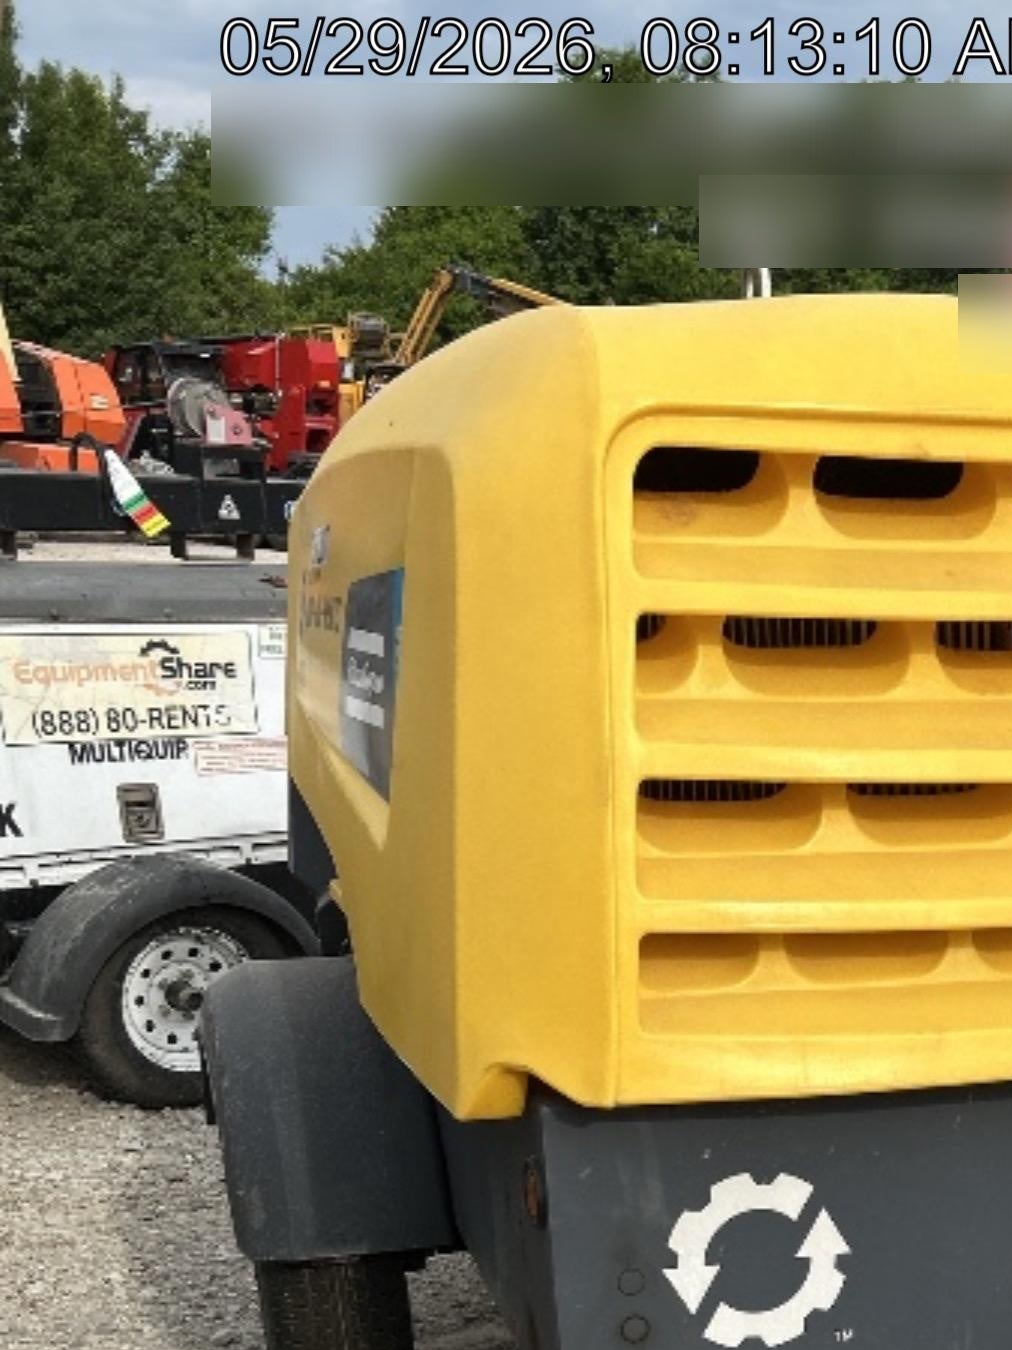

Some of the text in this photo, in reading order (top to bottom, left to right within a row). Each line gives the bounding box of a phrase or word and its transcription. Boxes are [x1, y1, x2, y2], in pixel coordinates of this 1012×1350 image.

[183, 680, 217, 691] .com
[32, 704, 231, 738] (888) 80-RENTS
[68, 738, 189, 765] MULTIQUIP
[833, 1327, 854, 1343] TM
